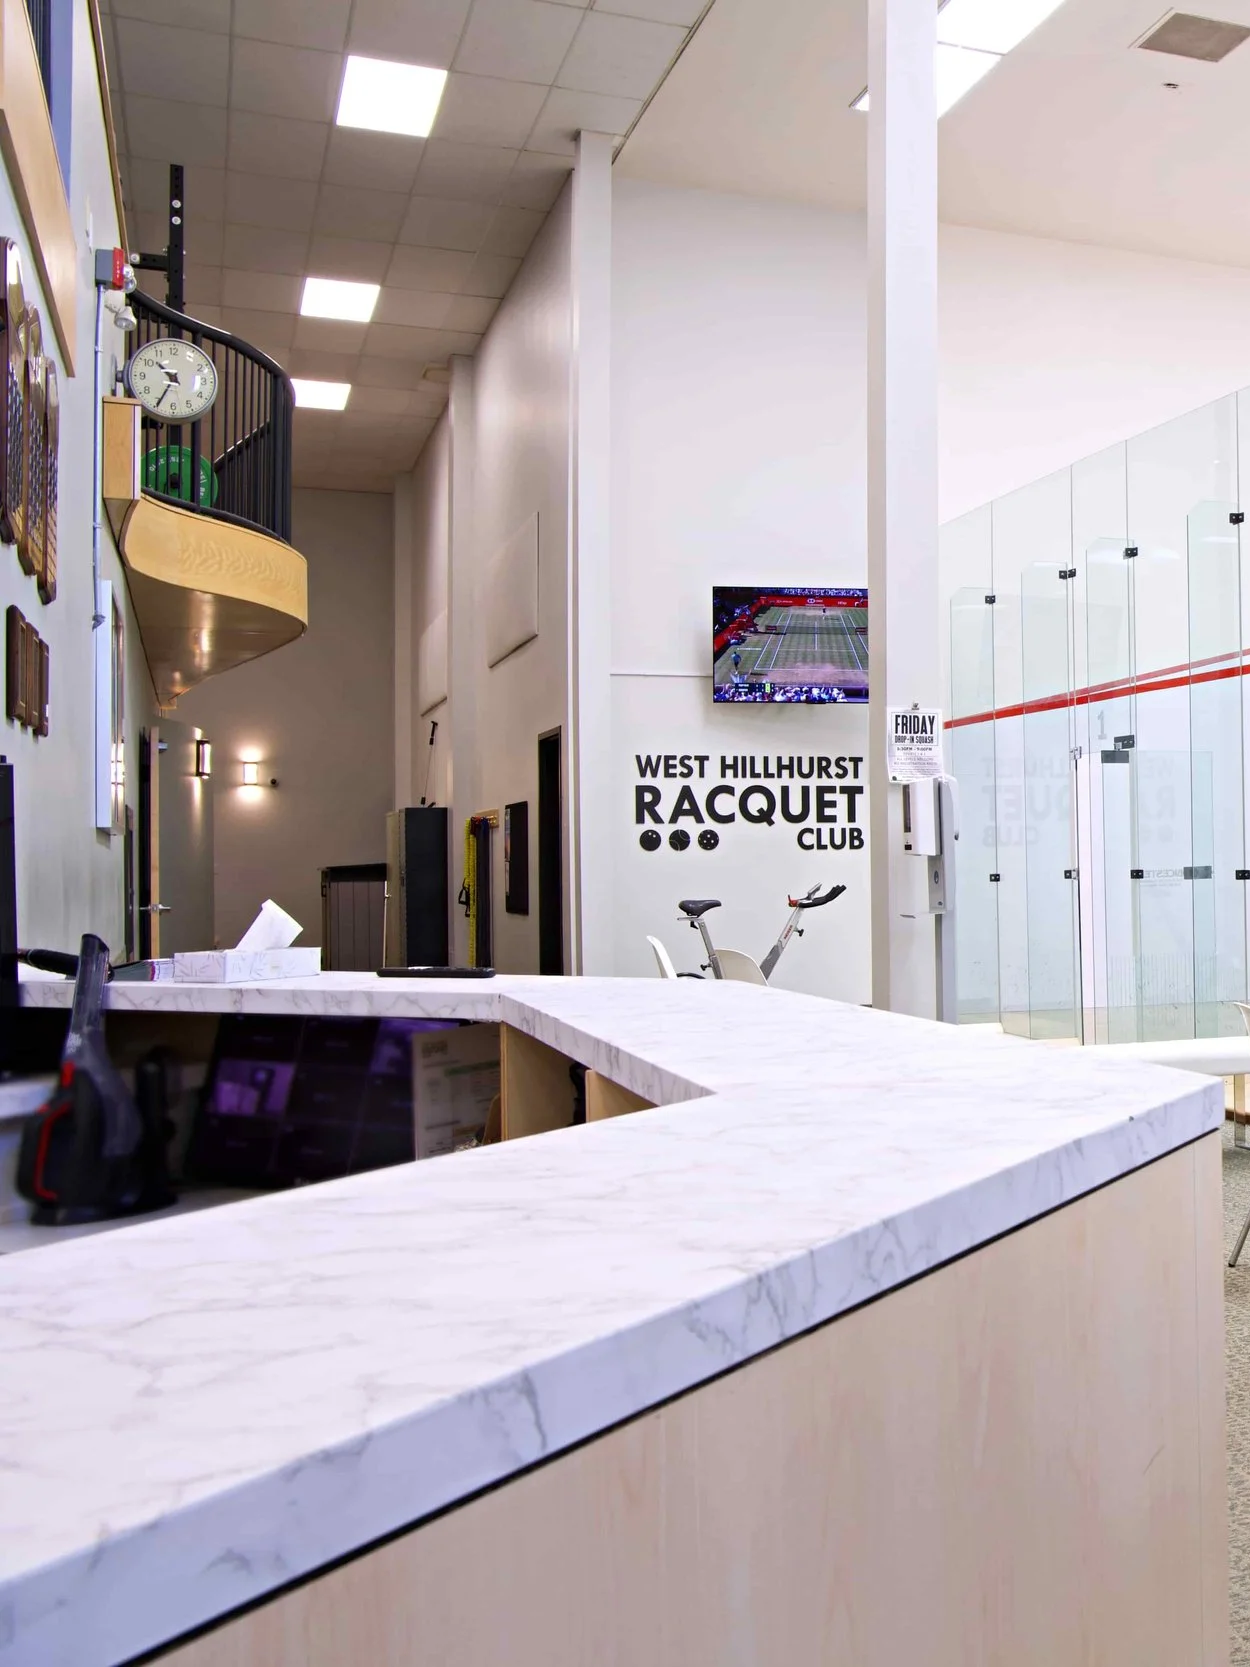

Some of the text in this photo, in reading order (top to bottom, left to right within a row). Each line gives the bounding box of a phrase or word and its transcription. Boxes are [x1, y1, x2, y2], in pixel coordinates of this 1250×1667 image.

[169, 347, 178, 356] 12
[144, 359, 154, 367] 10
[197, 364, 203, 372] 2
[139, 372, 146, 380] 9
[200, 377, 207, 386] 3
[144, 386, 150, 394] 8
[170, 402, 176, 410] 6
[185, 400, 192, 408] 5
[894, 714, 936, 735] FRIDAY
[1097, 709, 1108, 740] 1
[894, 735, 934, 744] DROP-IN SQUASH
[635, 754, 864, 779] WEST HILLHURST
[635, 784, 864, 827] RACQUET
[796, 827, 865, 851] CLUB
